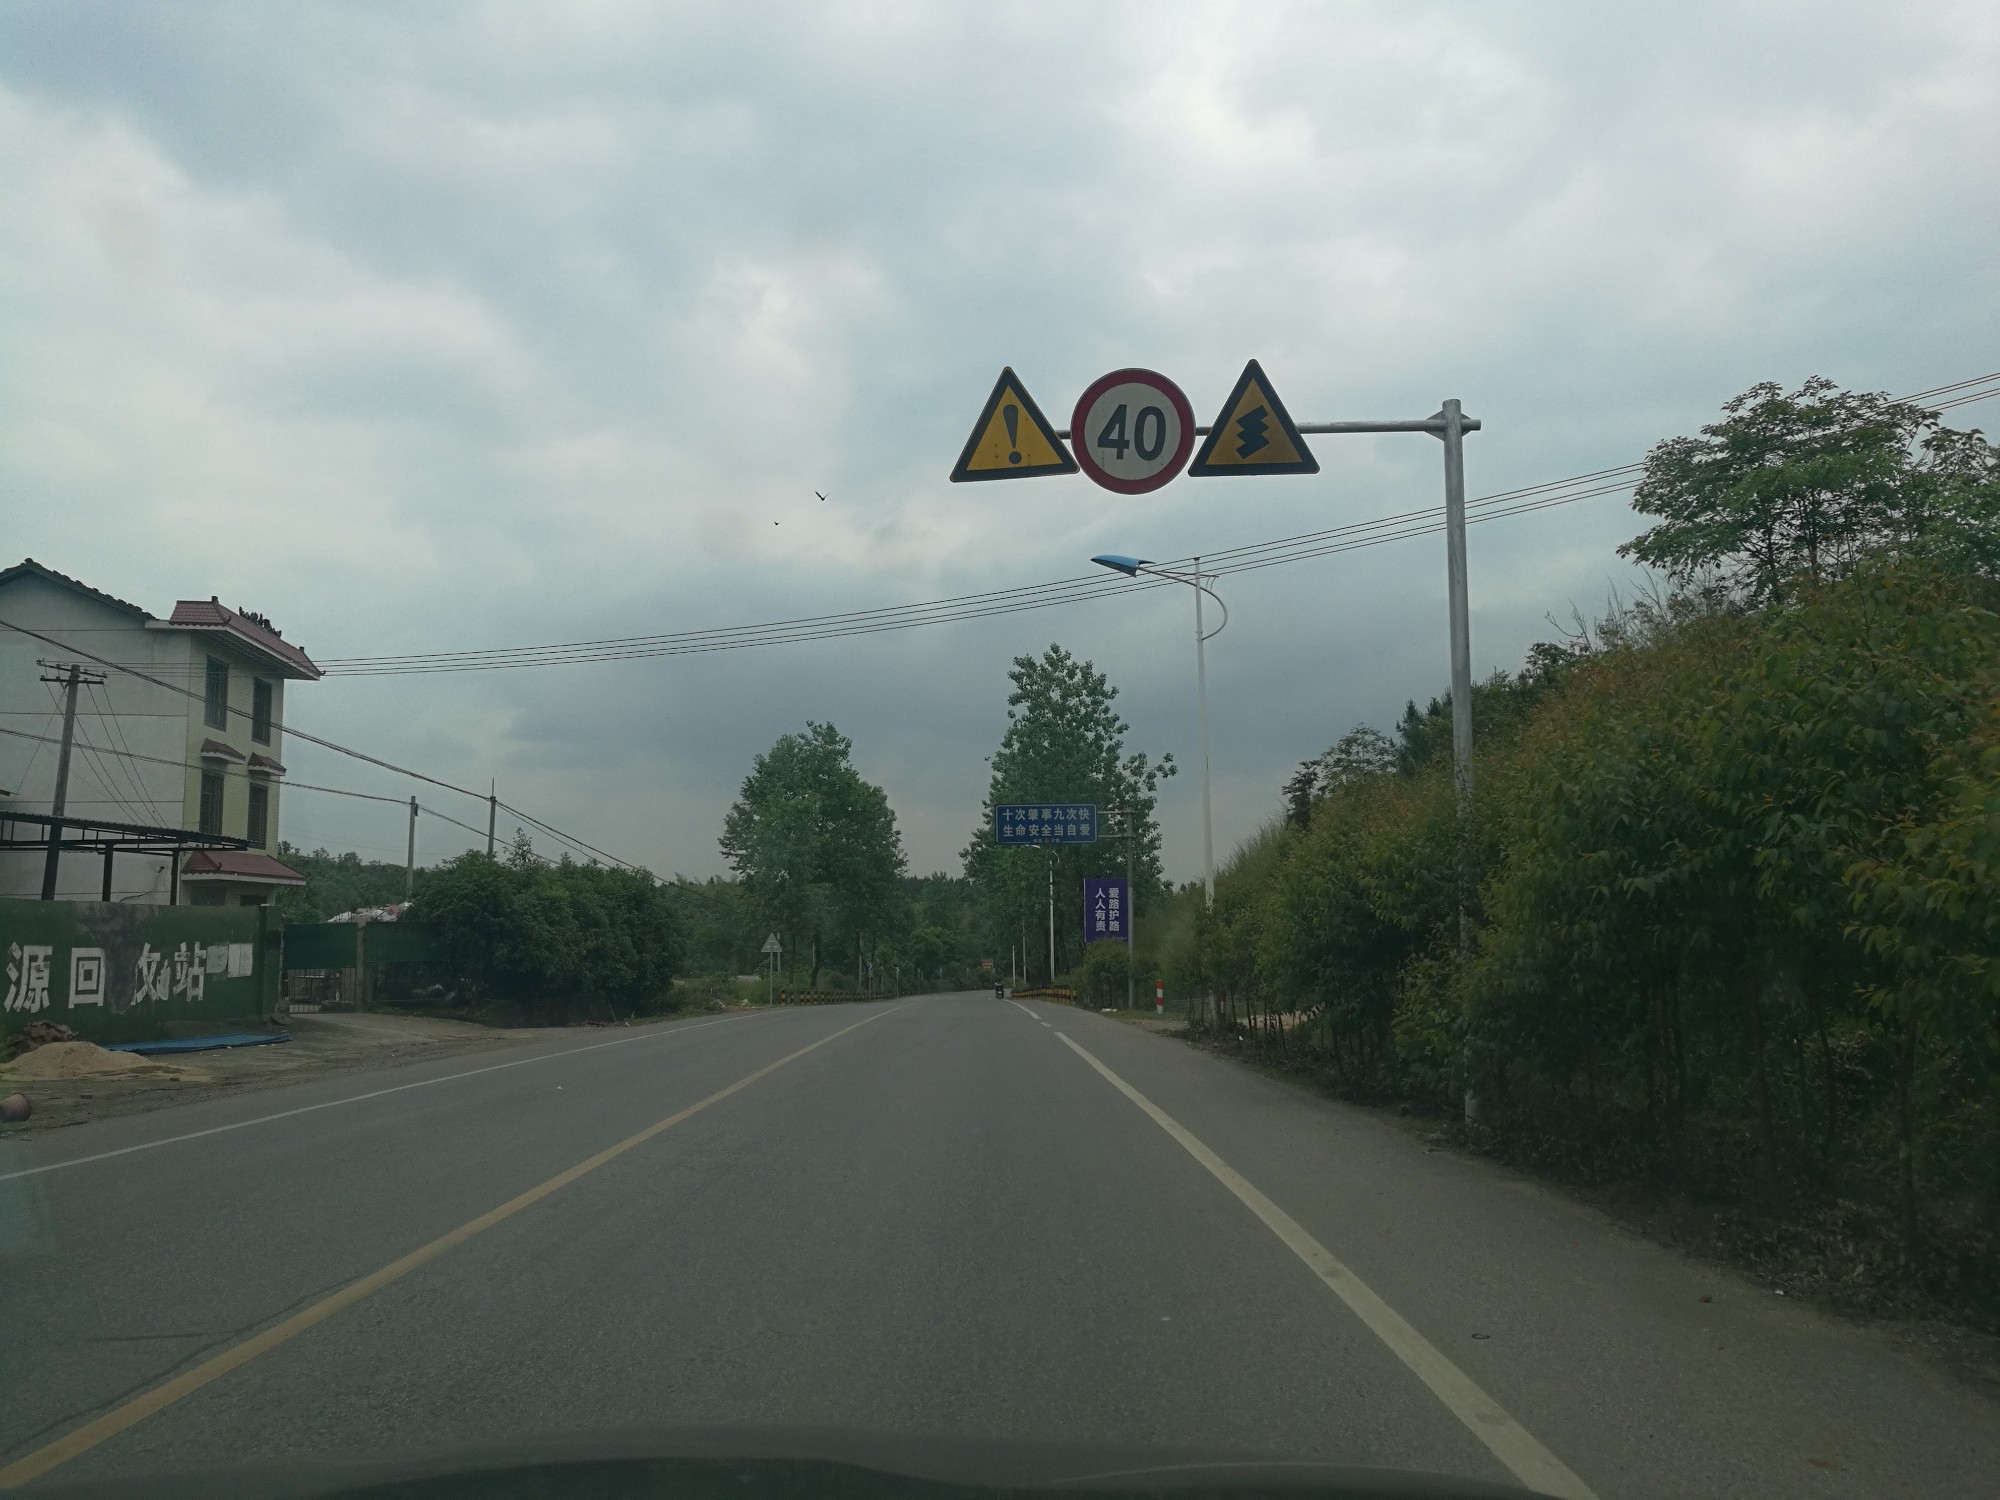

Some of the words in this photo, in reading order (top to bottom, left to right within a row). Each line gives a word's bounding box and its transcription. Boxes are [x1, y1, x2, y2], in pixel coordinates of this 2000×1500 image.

[1097, 404, 1167, 461] 40
[1002, 808, 1090, 821] 十次肇事九次快
[1003, 824, 1091, 837] 生命安全当自爱
[1095, 887, 1106, 932] 人人有责
[1108, 887, 1120, 932] 爱路护路
